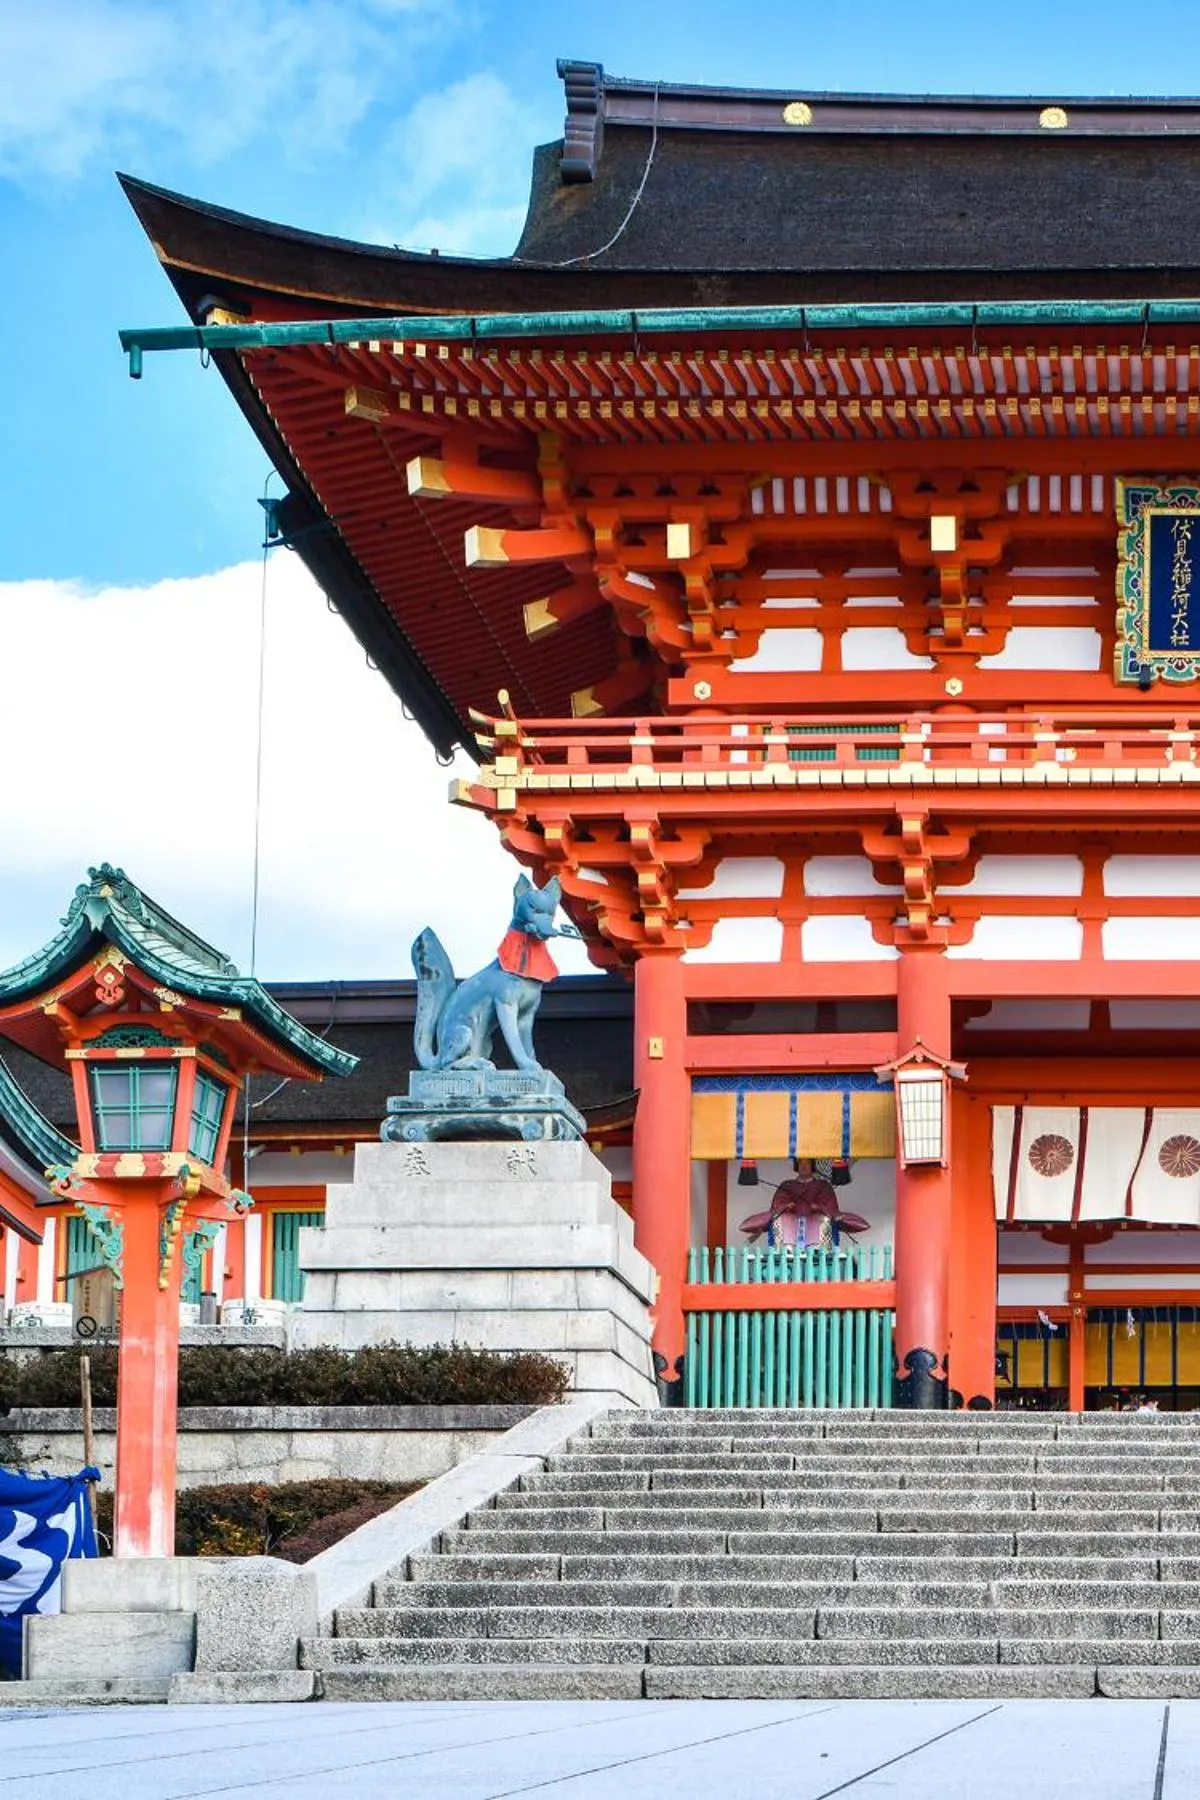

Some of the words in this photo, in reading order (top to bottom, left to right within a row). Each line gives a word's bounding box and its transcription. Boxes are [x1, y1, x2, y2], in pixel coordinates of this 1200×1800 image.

[1170, 519, 1194, 647] 伏見稲荷大社
